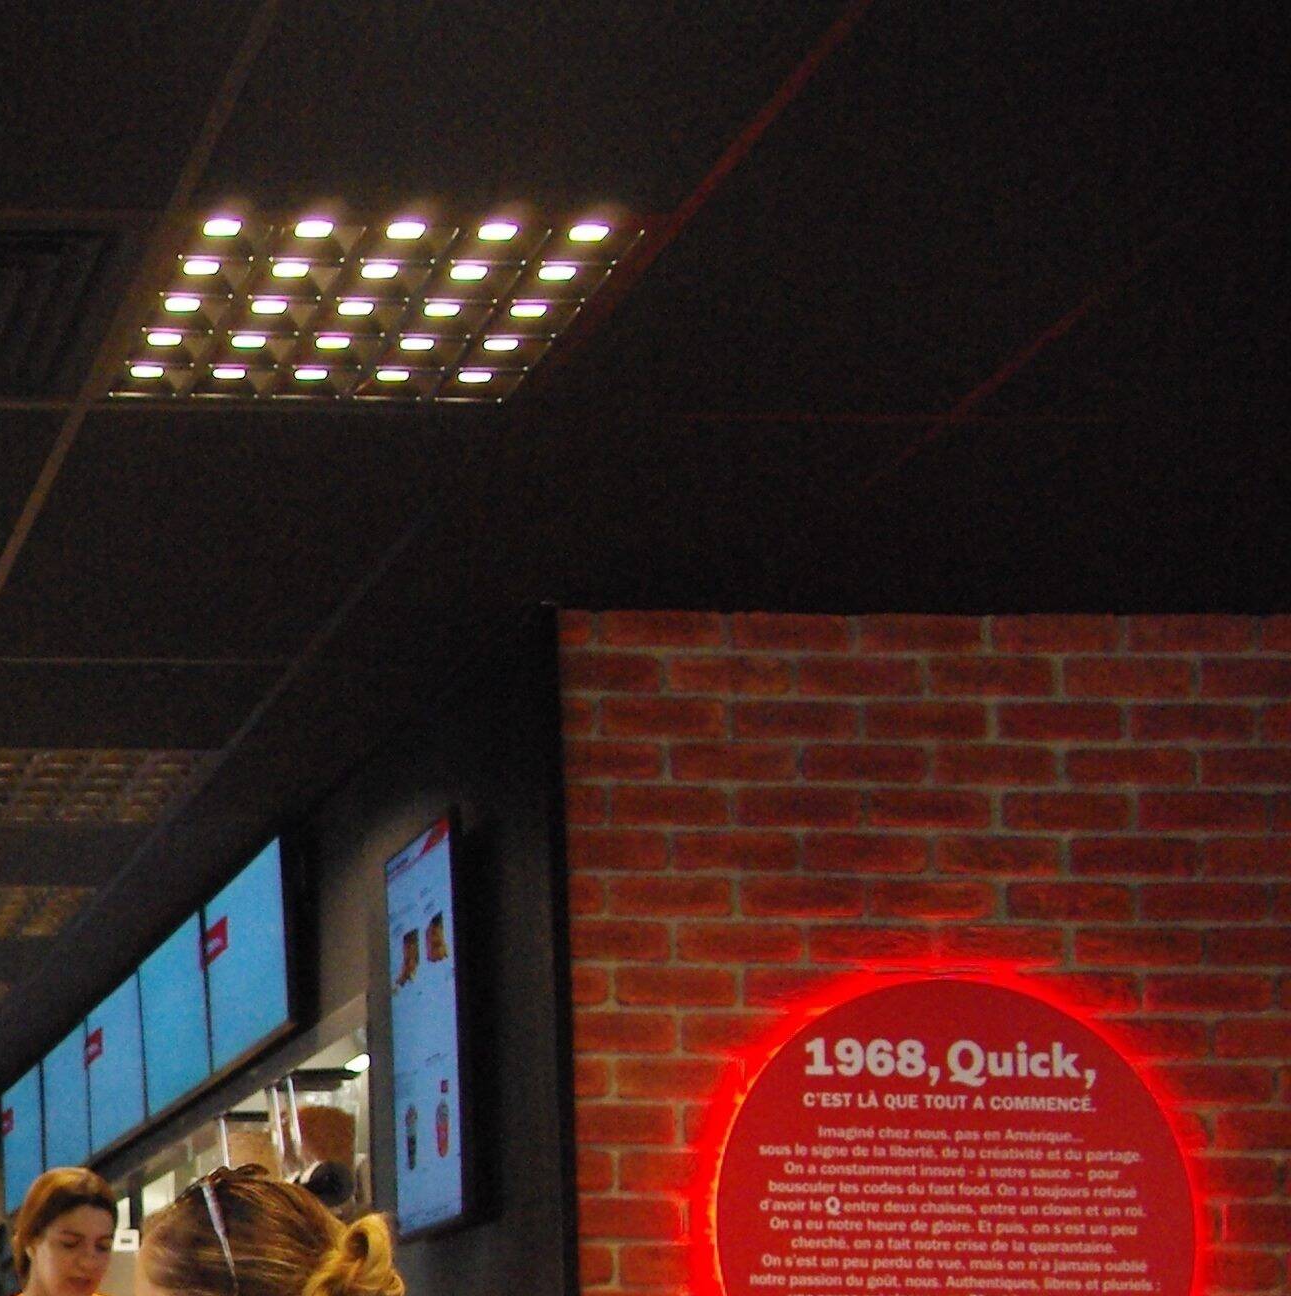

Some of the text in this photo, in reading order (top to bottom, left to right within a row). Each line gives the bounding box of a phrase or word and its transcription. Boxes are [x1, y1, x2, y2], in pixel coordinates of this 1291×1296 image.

[805, 1038, 1095, 1088] 1968, Quick,
[803, 1091, 1095, 1111] C'EST LÀ QUE TOUT A COMMENCÉ.
[818, 1126, 979, 1141] Imaginé chez pas
[759, 1145, 1082, 1160] sous signe la créativité et du
[784, 1161, 1119, 1181] On constamment innové notre sauce pour
[768, 1180, 1136, 1199] bousculer les codes du fast On toujours refusé
[809, 1200, 821, 1211] le
[825, 1196, 840, 1214] Q
[844, 1202, 878, 1212] entre
[883, 1201, 915, 1212] deux
[980, 1203, 1015, 1214] entre
[1020, 1205, 1037, 1214] un
[1041, 1204, 1081, 1215] clown
[1085, 1206, 1098, 1215] et
[1103, 1207, 1120, 1216] un
[770, 1216, 789, 1229] On
[805, 1220, 823, 1229] eu
[826, 1219, 862, 1230] notre
[867, 1219, 906, 1230] heure
[910, 1220, 927, 1231] de
[978, 1220, 991, 1232] Et
[1032, 1224, 1049, 1233] on
[1090, 1225, 1107, 1234] un
[1110, 1226, 1137, 1236] peu
[853, 1238, 1024, 1251] on fait notre crise de la
[761, 1254, 780, 1266] On
[821, 1258, 838, 1267] un
[842, 1258, 868, 1269] peu
[872, 1256, 912, 1270] perdu
[916, 1257, 933, 1268] de
[969, 1258, 1004, 1269] mais
[1007, 1261, 1024, 1269] on
[1053, 1260, 1100, 1273] jamais
[1104, 1260, 1147, 1271] oublié
[750, 1273, 1153, 1292] notre passion du libres et pluriels
